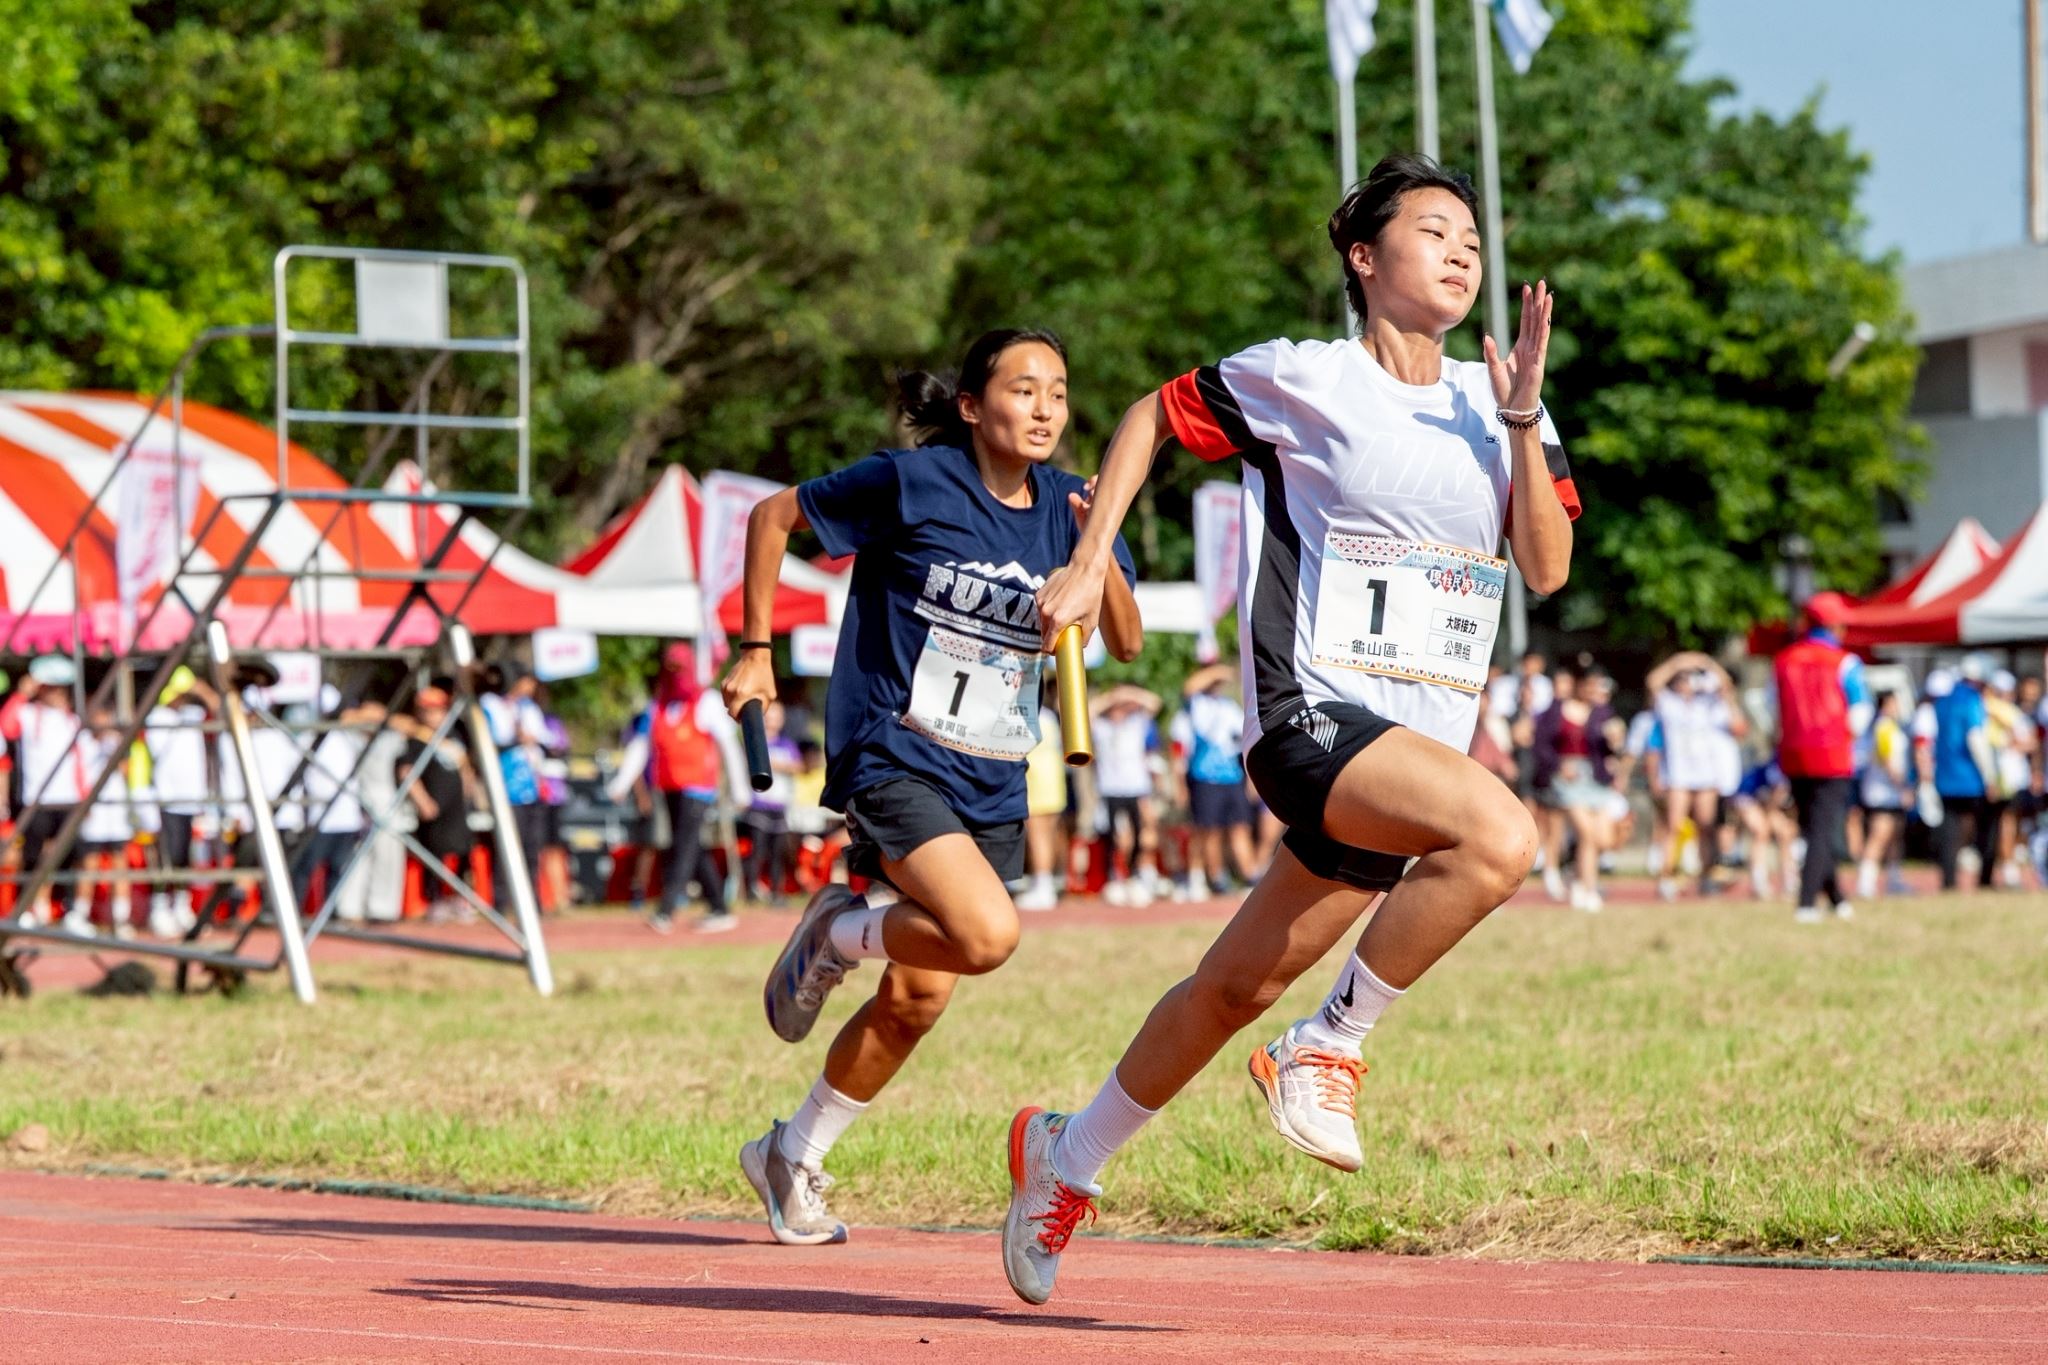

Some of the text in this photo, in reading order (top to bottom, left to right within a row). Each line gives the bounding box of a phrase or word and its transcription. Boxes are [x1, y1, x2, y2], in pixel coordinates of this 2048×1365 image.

[1366, 578, 1388, 636] 1
[1445, 615, 1478, 635] 大隊接力
[1351, 638, 1399, 659] 龜山區
[948, 670, 971, 717] 1
